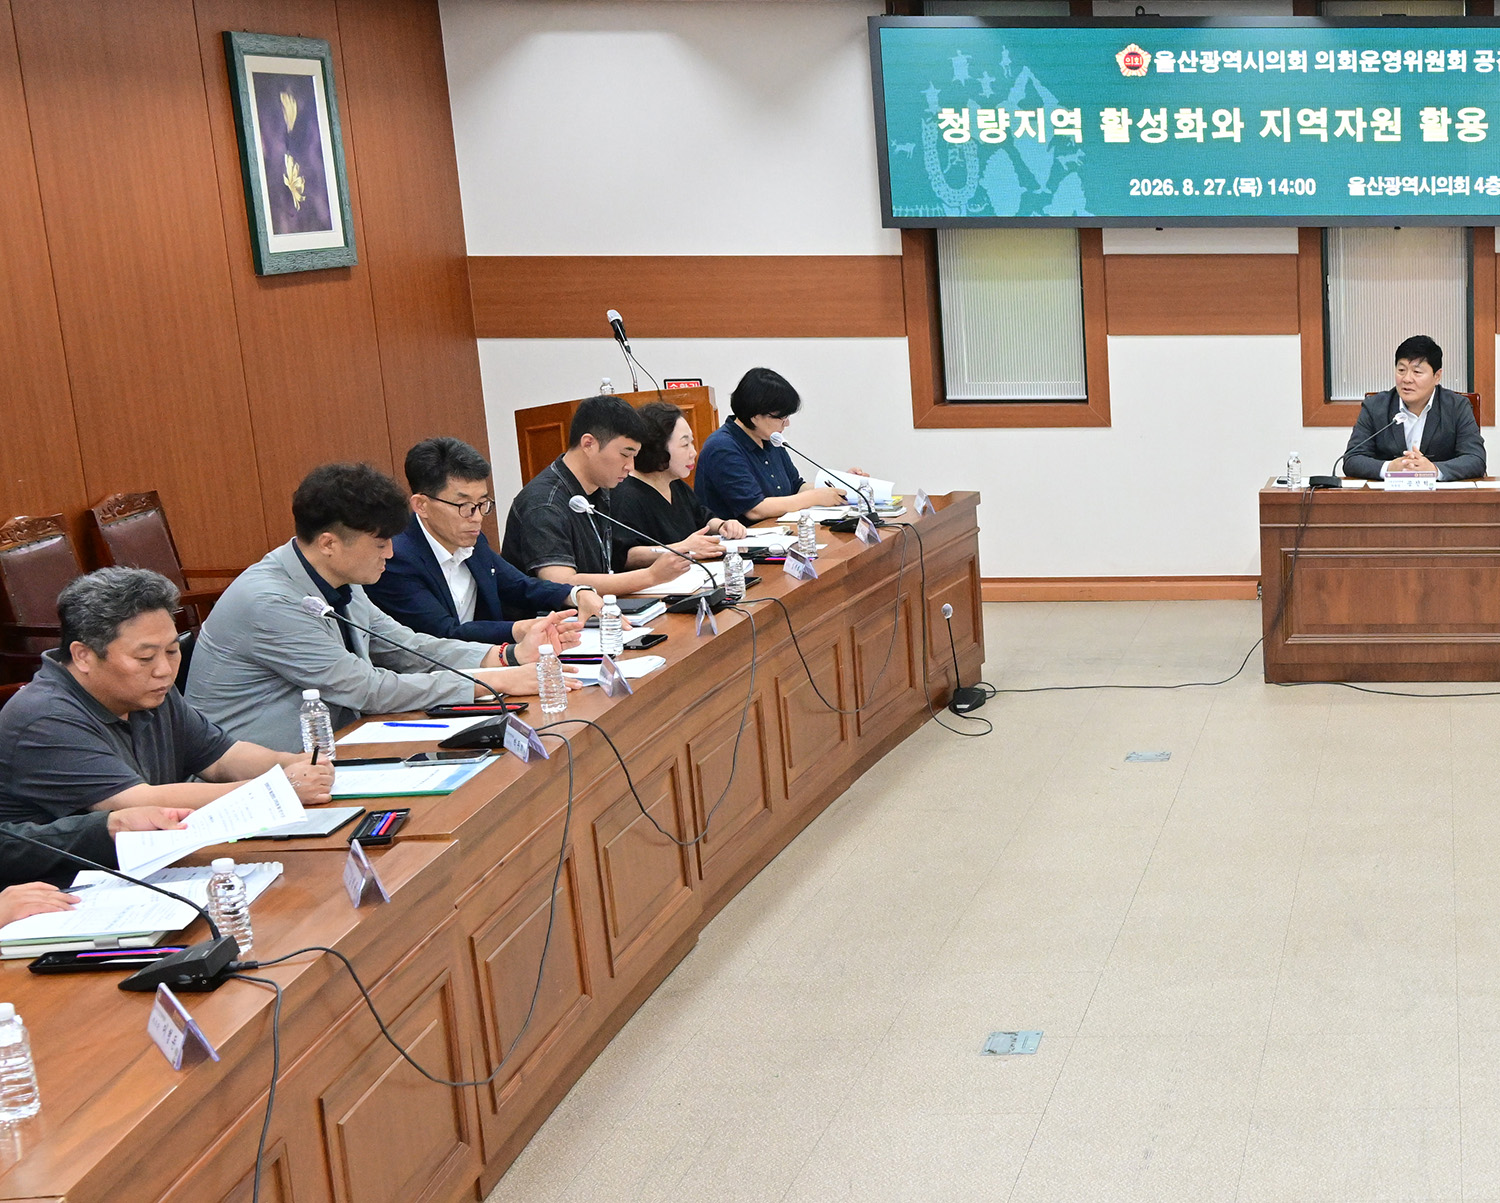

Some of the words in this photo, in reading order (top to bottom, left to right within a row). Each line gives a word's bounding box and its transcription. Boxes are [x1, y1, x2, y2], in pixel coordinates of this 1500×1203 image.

[1153, 49, 1308, 74] 울산광역시의회
[1314, 49, 1467, 73] 의회운영위원회
[937, 107, 1083, 144] 청량지역
[1099, 107, 1245, 144] 활성화와
[1259, 107, 1402, 143] 지역자원
[1419, 106, 1489, 143] 활용
[1129, 178, 1180, 196] 2026.
[1182, 178, 1200, 196] 8.
[1203, 177, 1263, 198] 27.(목)
[1267, 178, 1317, 196] 14:00
[1347, 176, 1471, 197] 울산광역시의회
